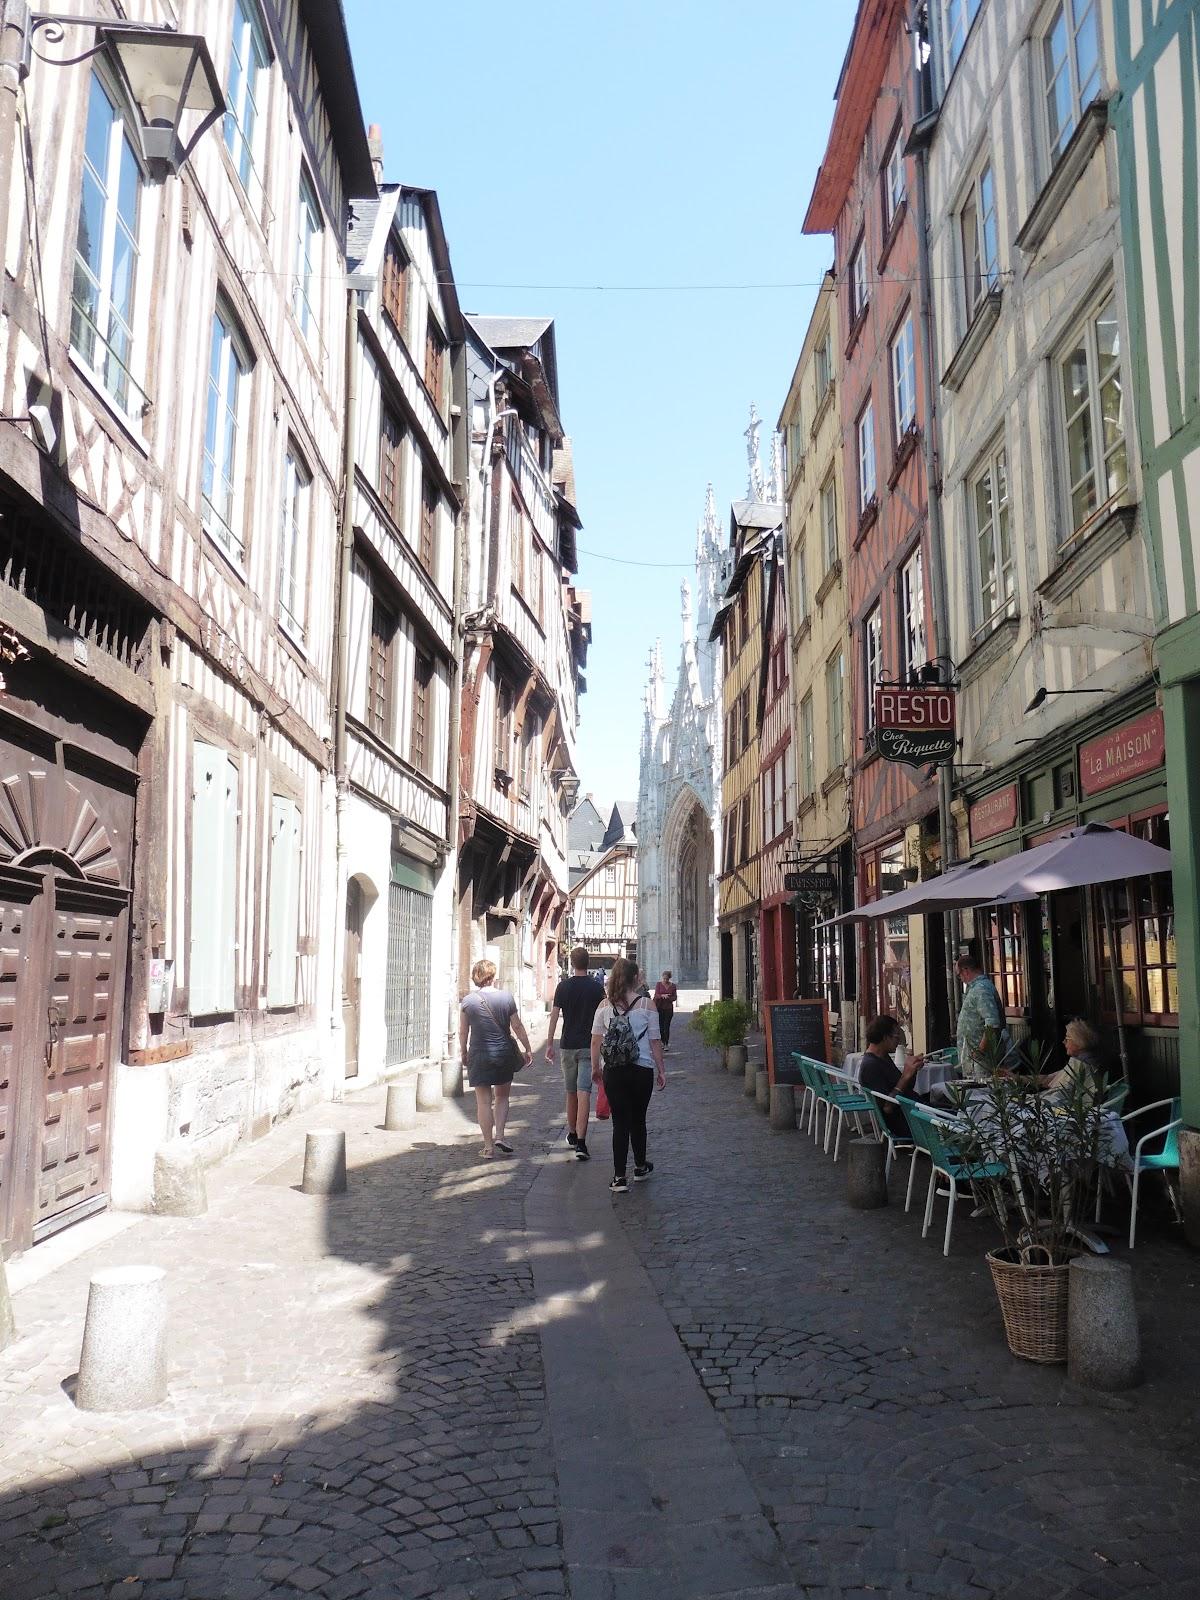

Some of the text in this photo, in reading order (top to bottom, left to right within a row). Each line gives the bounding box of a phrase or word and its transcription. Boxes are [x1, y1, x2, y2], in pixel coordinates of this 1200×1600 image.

[881, 695, 951, 724] RESTO
[882, 730, 904, 741] Chez
[890, 739, 952, 757] Riquette
